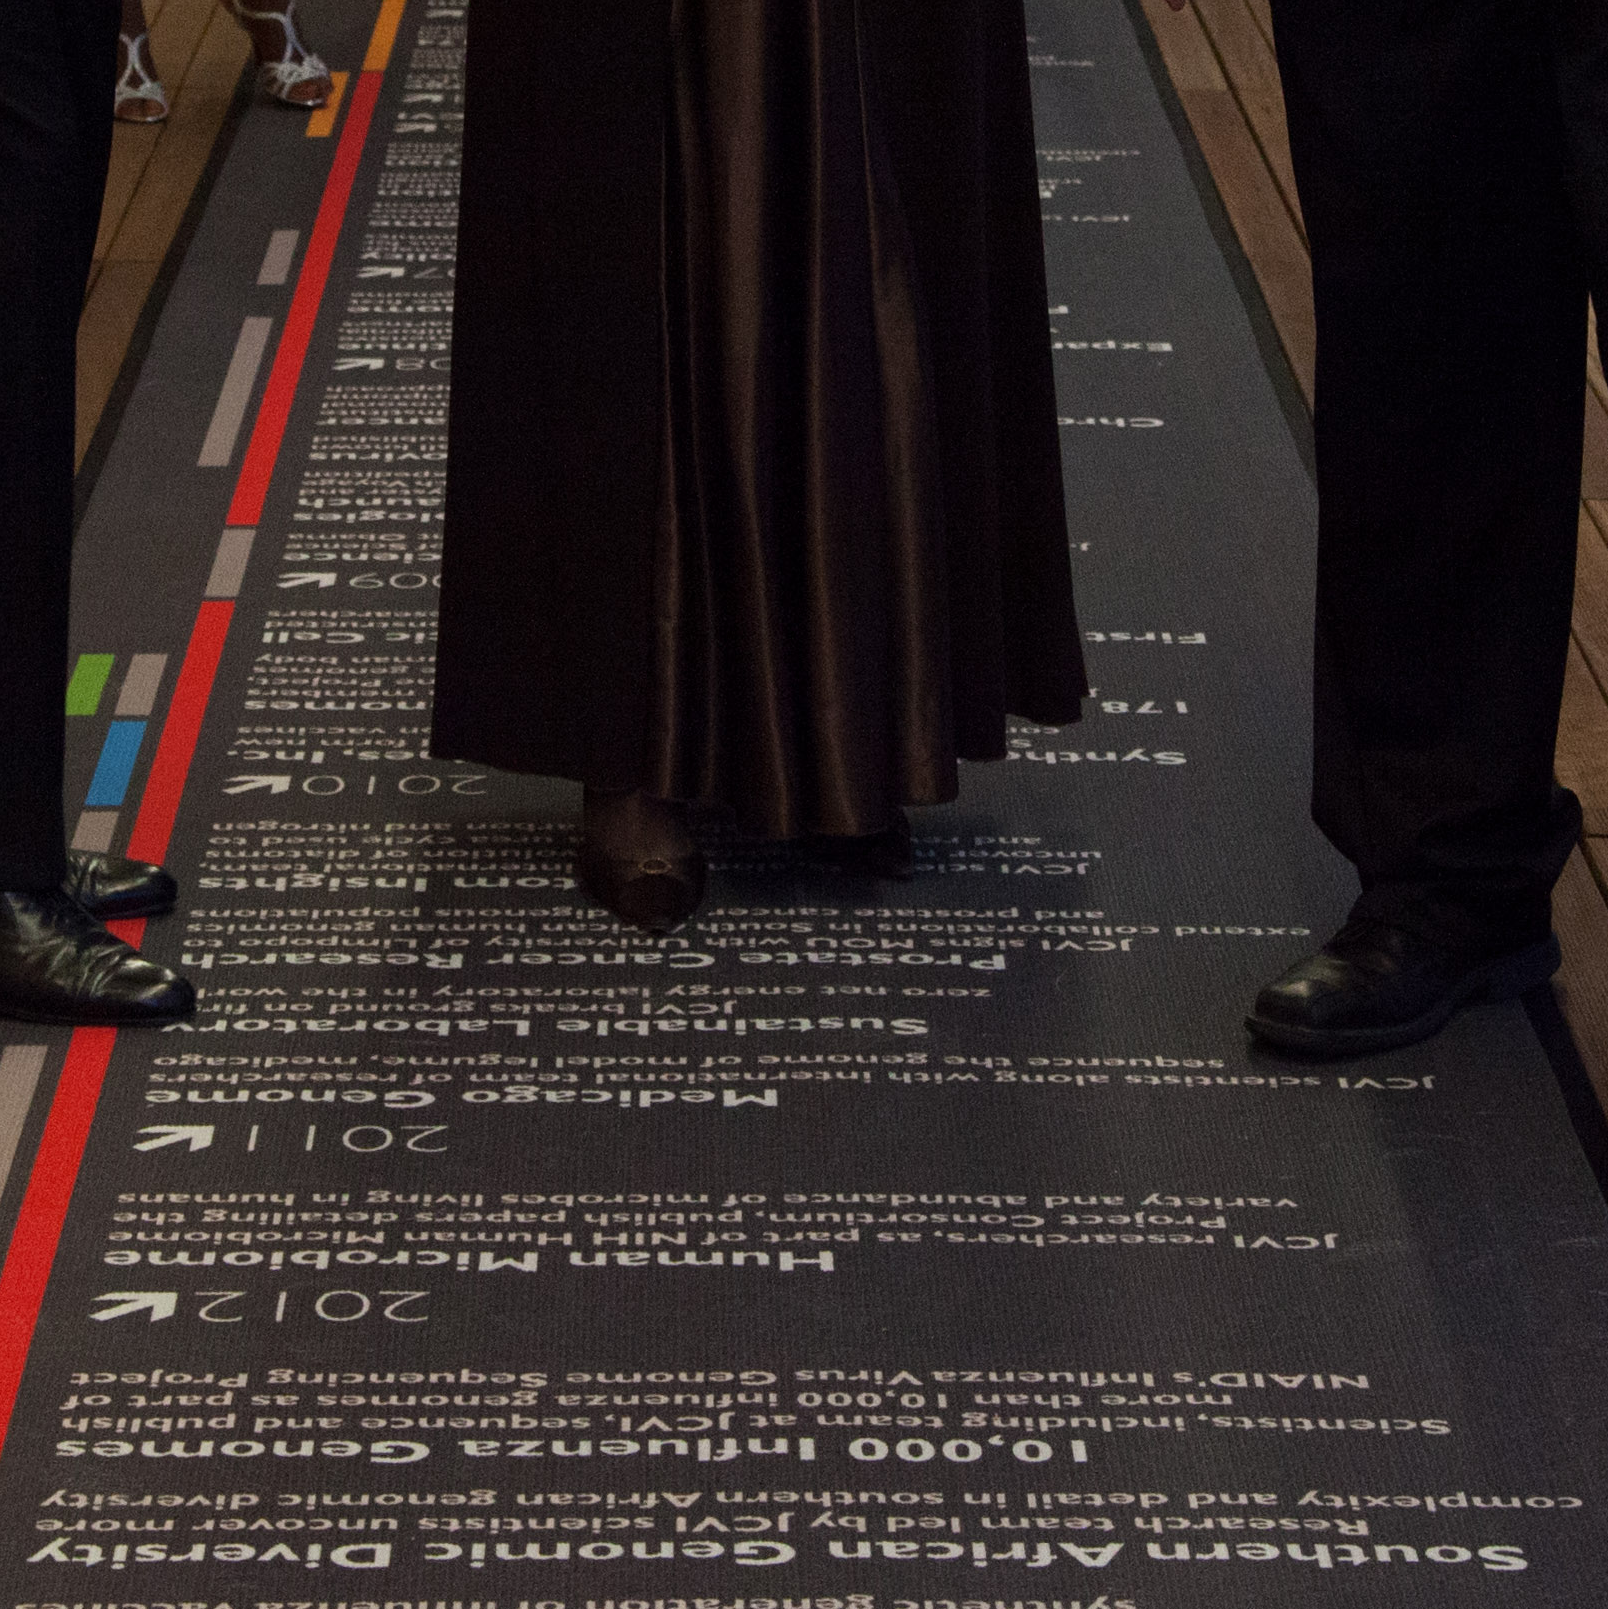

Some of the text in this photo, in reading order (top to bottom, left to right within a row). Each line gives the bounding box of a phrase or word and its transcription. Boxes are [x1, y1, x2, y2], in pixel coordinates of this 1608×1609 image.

[1084, 631, 1208, 645] First
[1100, 700, 1189, 715] 178
[301, 774, 488, 796] 2010
[211, 819, 452, 834] and nitrogen
[207, 835, 247, 847] to
[258, 835, 349, 849] used
[361, 835, 456, 847] cycle
[974, 836, 1042, 845] and
[203, 849, 362, 861] diatoms
[368, 849, 410, 861] of
[950, 849, 1103, 859] uncover
[198, 861, 310, 874] team,
[323, 863, 573, 874] international
[1000, 861, 1090, 874] JCVI
[197, 872, 428, 893] Insights
[189, 906, 1105, 922] and prostate cancer populations
[185, 921, 1311, 937] extend collaborations in South human genomics
[182, 935, 1134, 952] JCVI signs MOU with University of Limpopo to
[180, 951, 1007, 971] Prostate Cancer Research
[301, 984, 992, 1000] zero net energy laboratory in the
[263, 1000, 738, 1016] JCVI breaks ground on
[555, 1016, 930, 1037] Sustainable
[152, 1053, 1225, 1069] sequence the genome of model legume, medicago
[148, 1069, 1436, 1088] JCVI scientists along with international team of researchers
[144, 1085, 779, 1110] Medicago Genome
[246, 1124, 449, 1154] 2011
[117, 1191, 1299, 1210] variety and abundance of microbes living in humans
[112, 1209, 1228, 1229] Project Consortium, publish papers detailing the
[107, 1229, 1339, 1250] JCVI researchers, as part of NIH Human Microbiome
[102, 1249, 836, 1274] Human Microbiome
[194, 1289, 431, 1323] 2012
[69, 1368, 1371, 1390] NIAID's Influenza Virus Genome Sequencing Project
[58, 1389, 1234, 1411] more than 10,000 influenza genomes as part of
[61, 1411, 1452, 1435] Scientists, including team at JCVI, sequence and publish
[55, 1436, 1089, 1465] 10,000 Influenza Genomes
[40, 1489, 1584, 1513] complexity and detail in southern African genomic diversity
[34, 1512, 1370, 1535] Research team led by JCVI scientists uncover more
[25, 1536, 1530, 1571] Southern African Genomic Diversity
